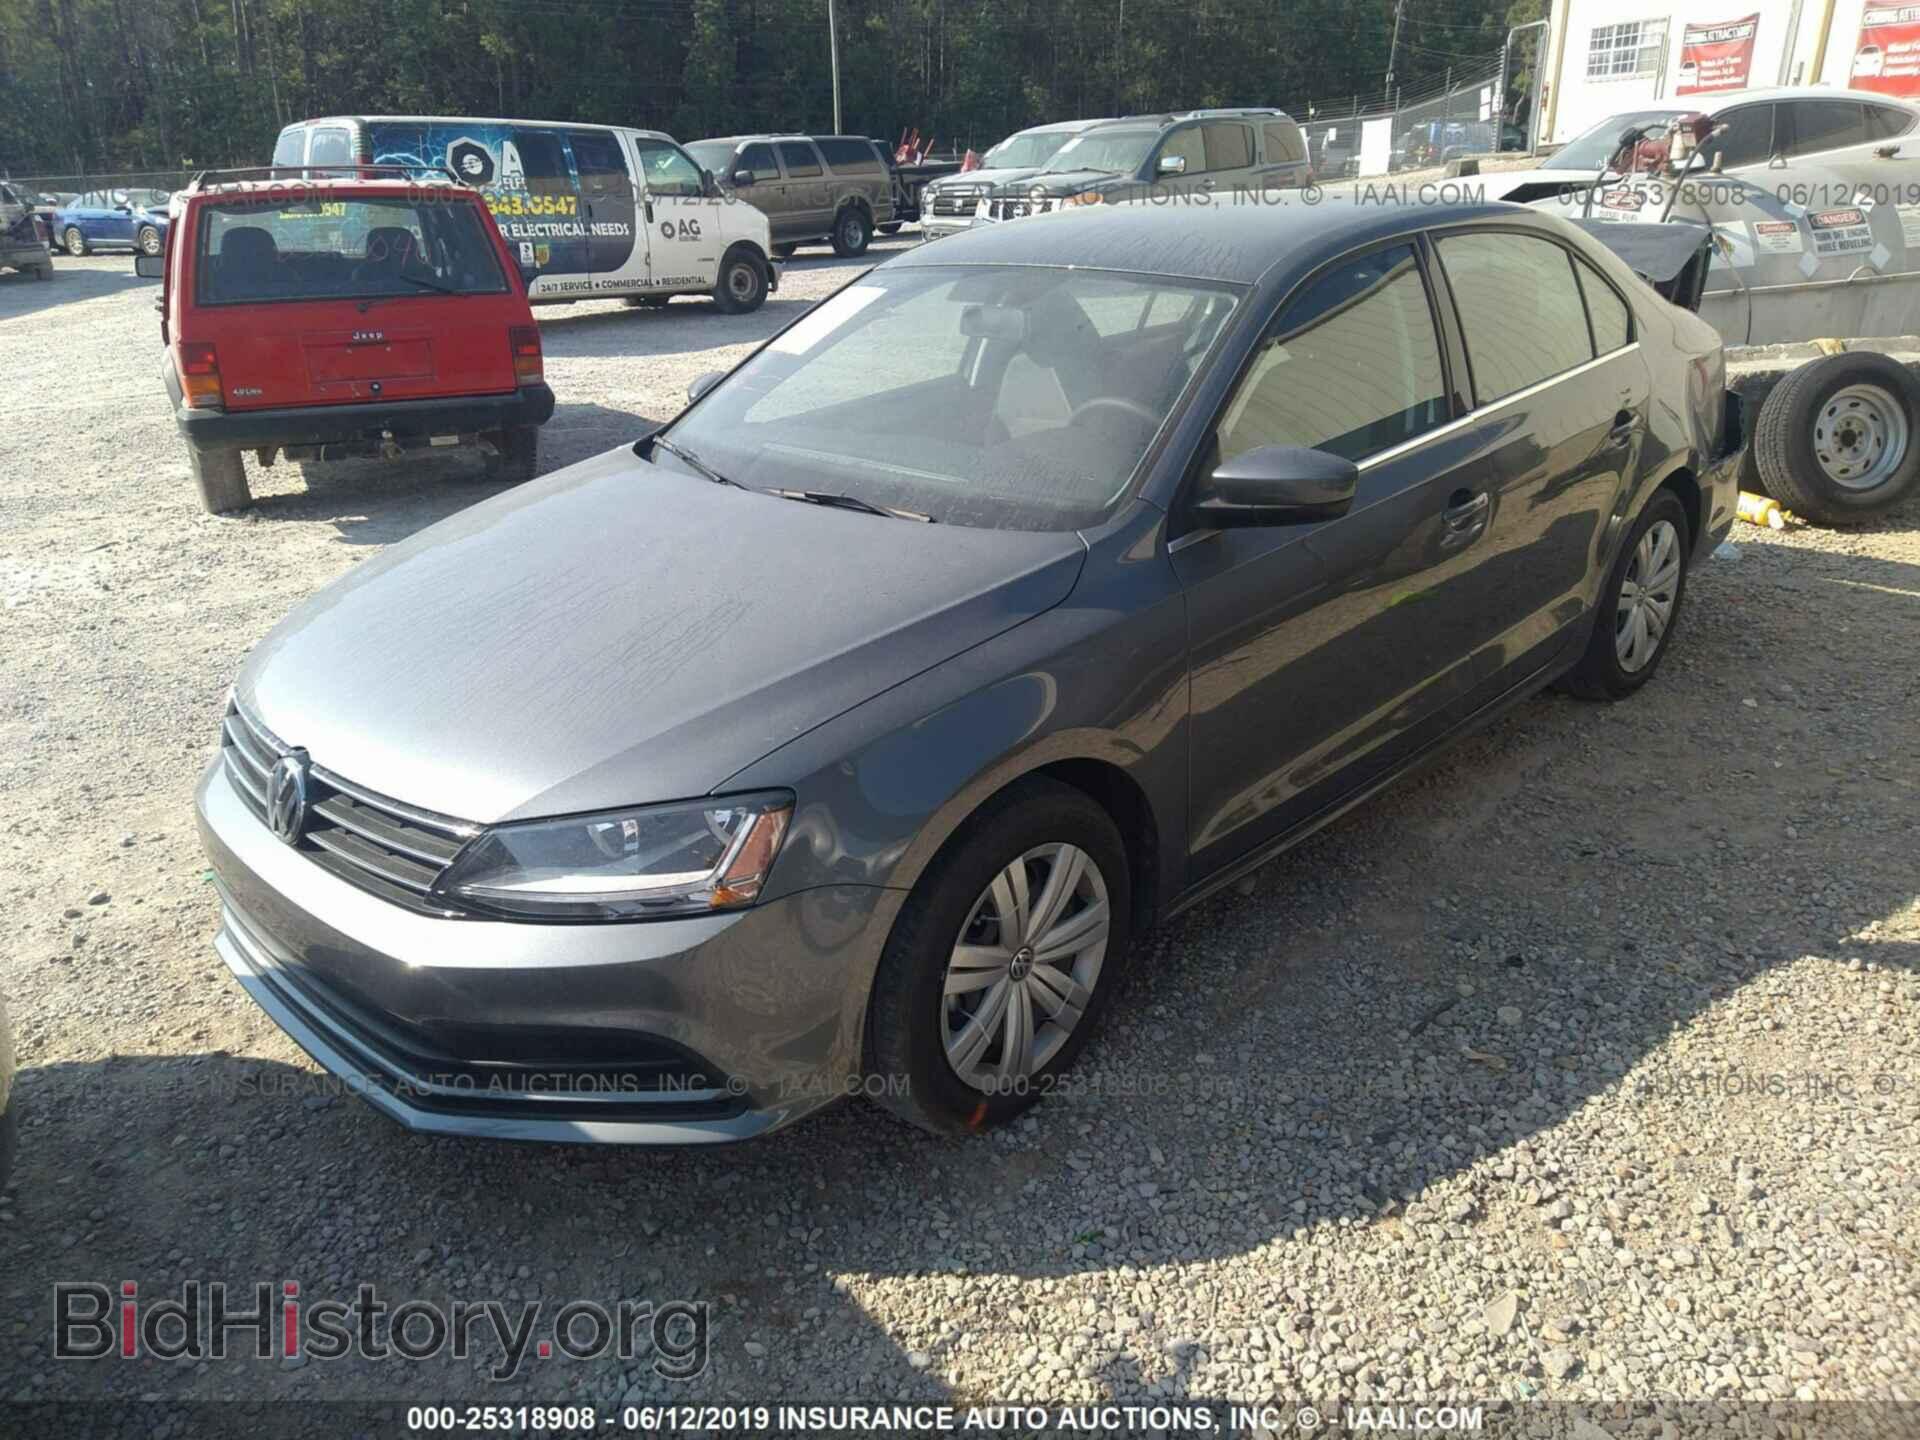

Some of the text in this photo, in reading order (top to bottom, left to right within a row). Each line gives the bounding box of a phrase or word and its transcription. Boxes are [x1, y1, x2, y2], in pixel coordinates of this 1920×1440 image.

[1815, 212, 1858, 225] DANGER
[511, 223, 586, 237] ELECTRICAL
[590, 222, 630, 236] NEEDS
[679, 218, 701, 235] AG
[541, 276, 706, 292] 24/7 SERVICE COMMERCIAL RESIDENTIAL
[352, 331, 384, 341] Jeep
